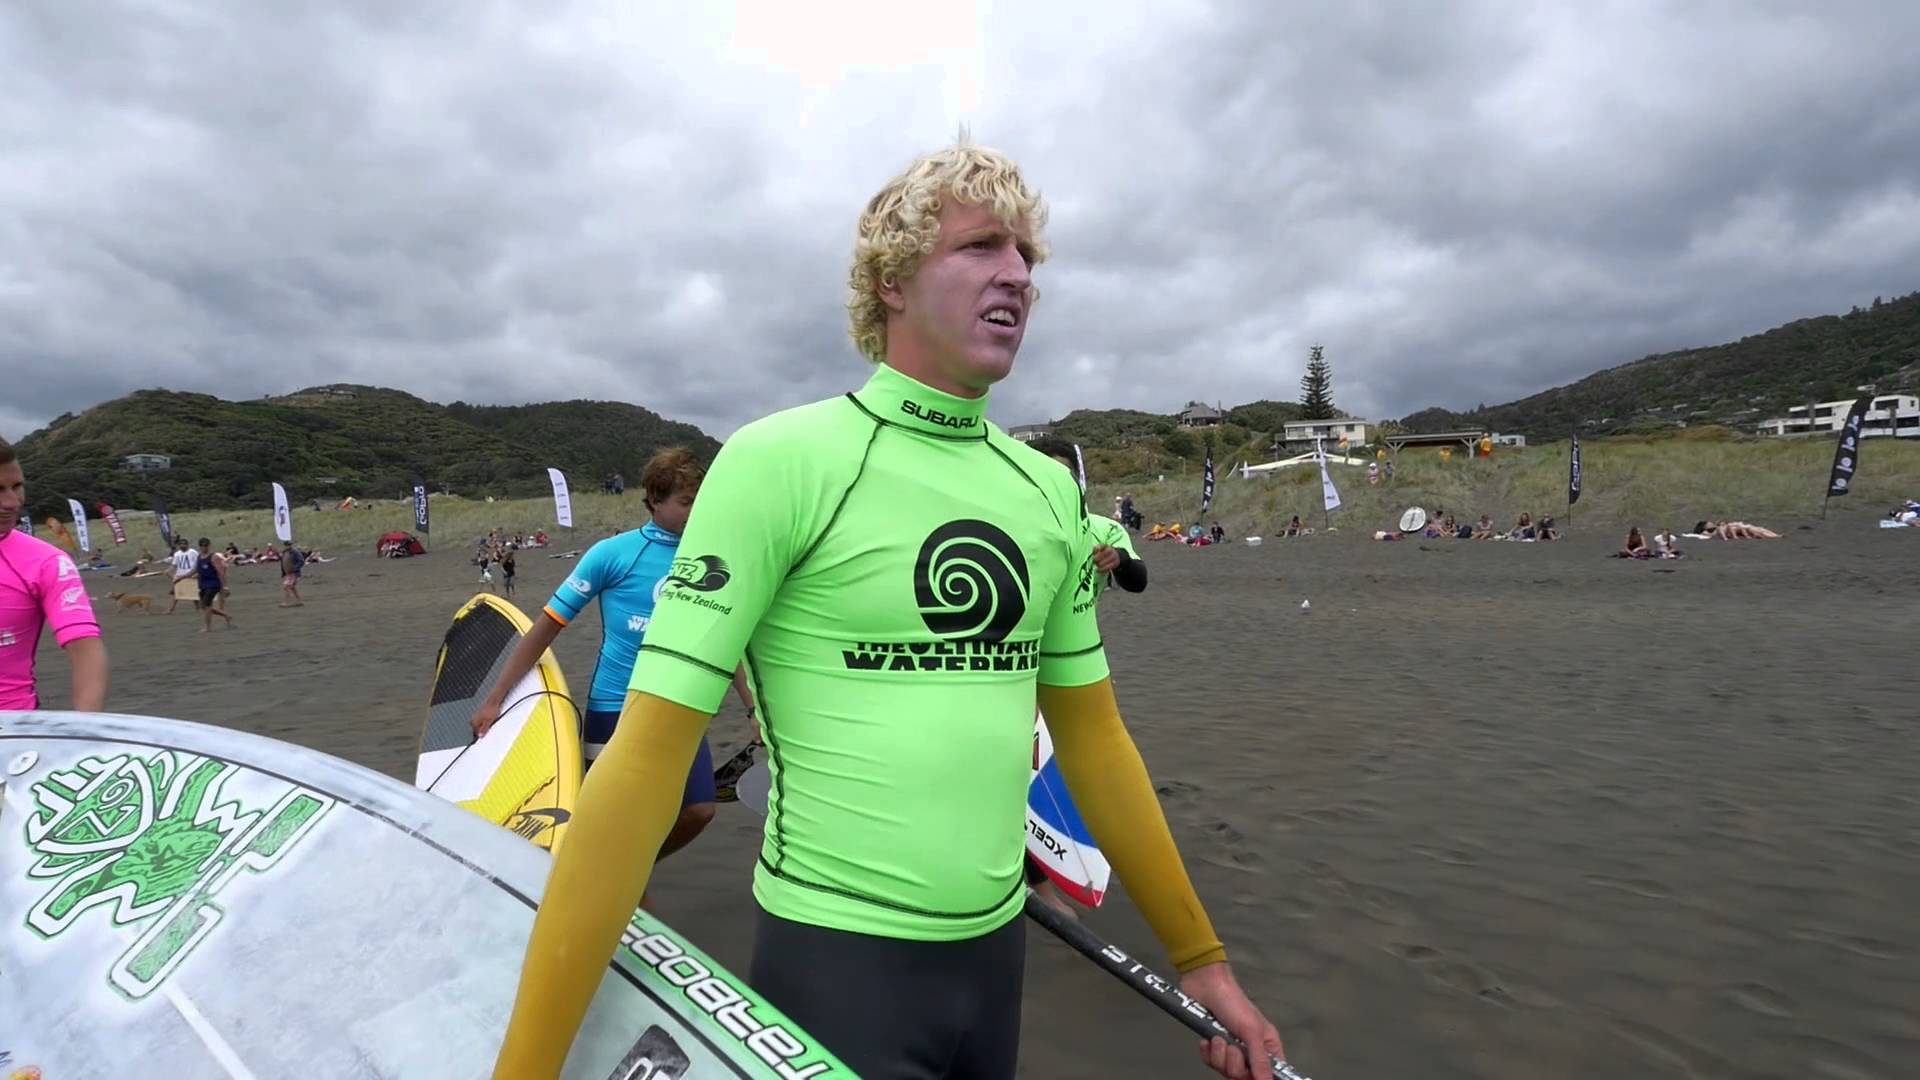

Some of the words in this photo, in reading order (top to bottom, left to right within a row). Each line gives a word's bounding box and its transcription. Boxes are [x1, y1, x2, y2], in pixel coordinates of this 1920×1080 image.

[900, 399, 979, 429] SUBARU
[675, 590, 693, 602] New
[692, 594, 734, 616] Zealand
[1028, 818, 1068, 862] XCEL
